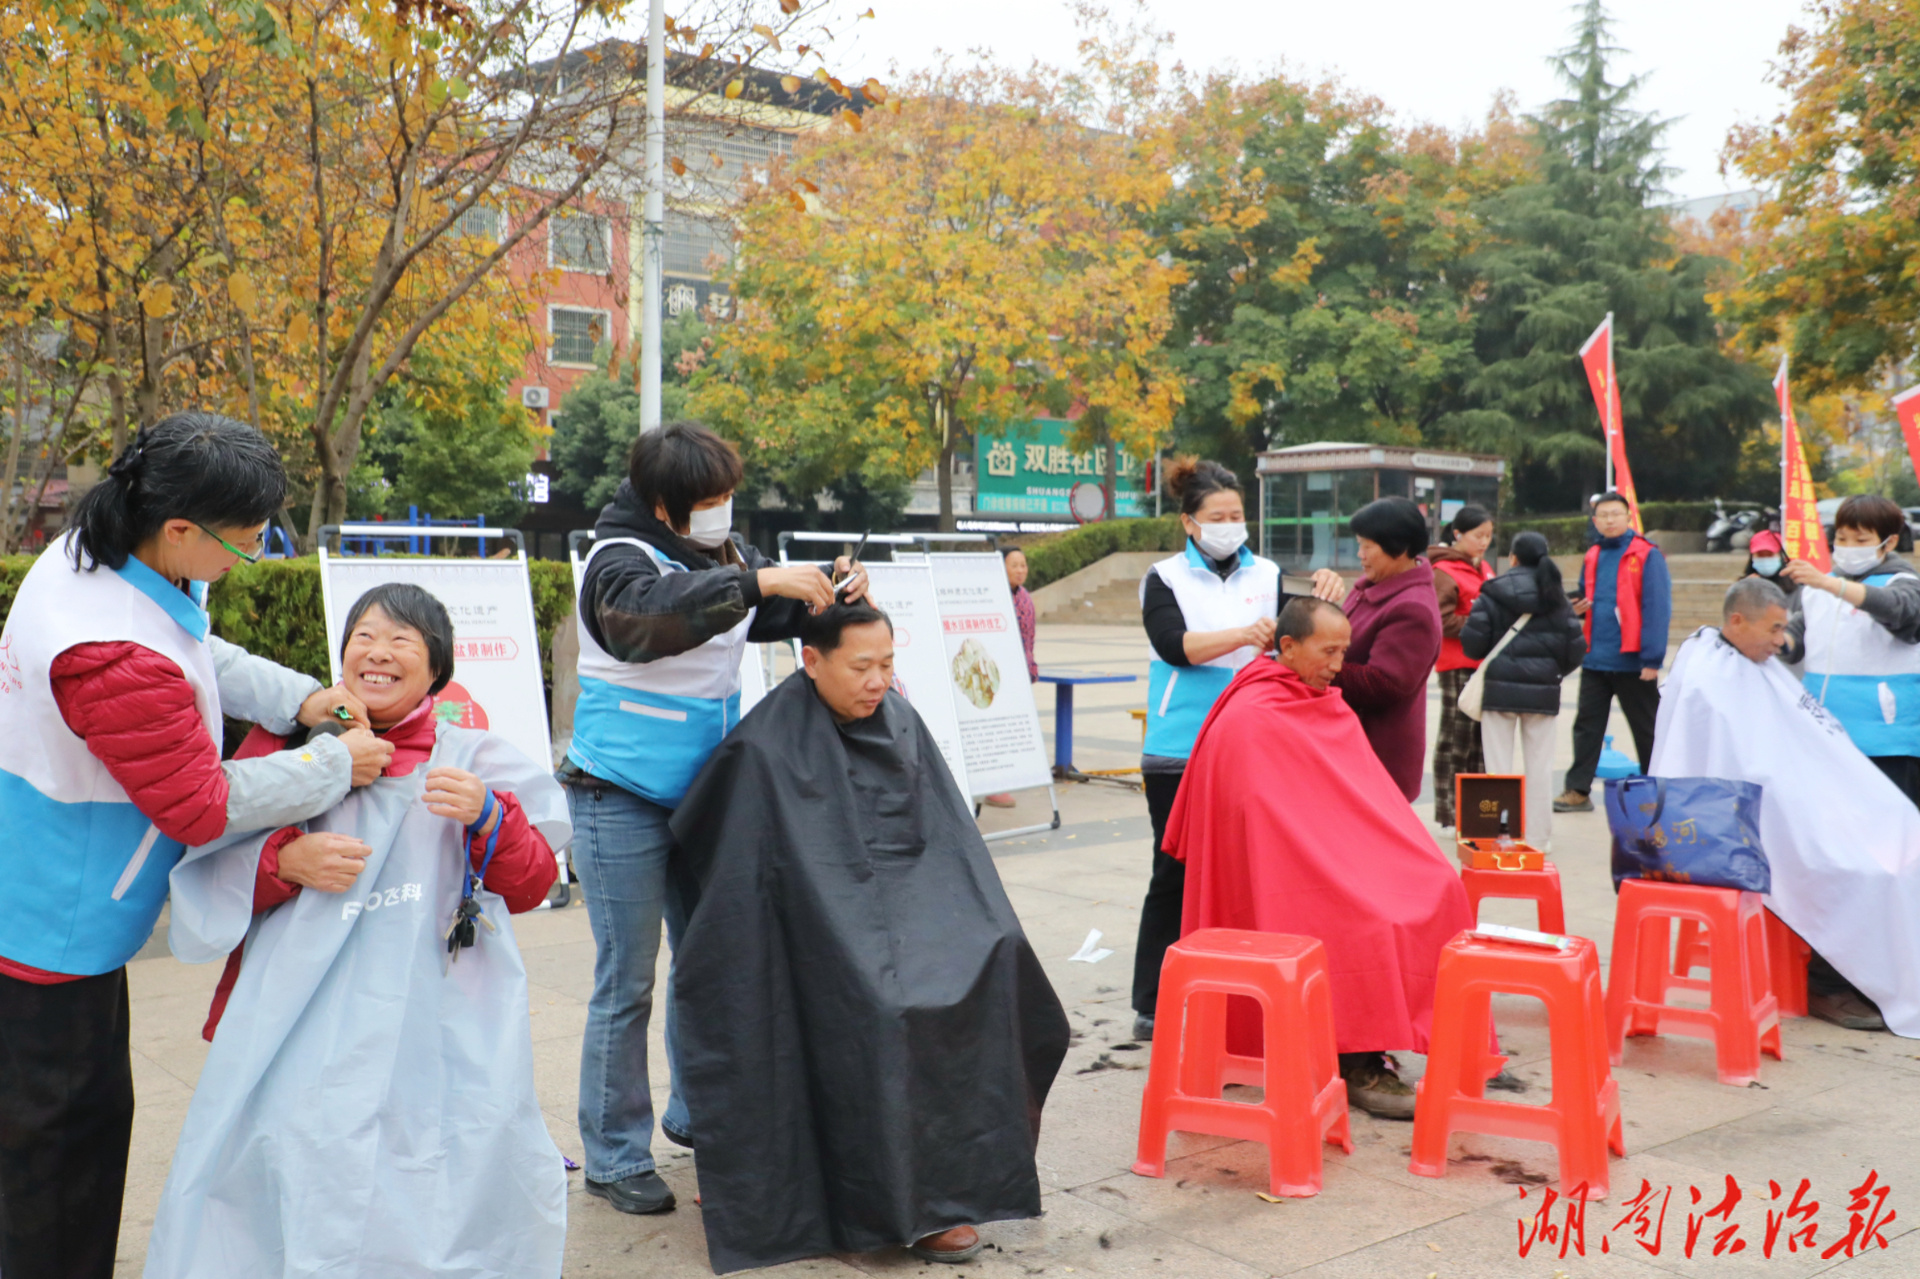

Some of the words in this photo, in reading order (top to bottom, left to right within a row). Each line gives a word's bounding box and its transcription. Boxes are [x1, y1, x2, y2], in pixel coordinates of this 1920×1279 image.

[1026, 486, 1073, 497] SHUANGS
[448, 605, 498, 616] 文化遗产
